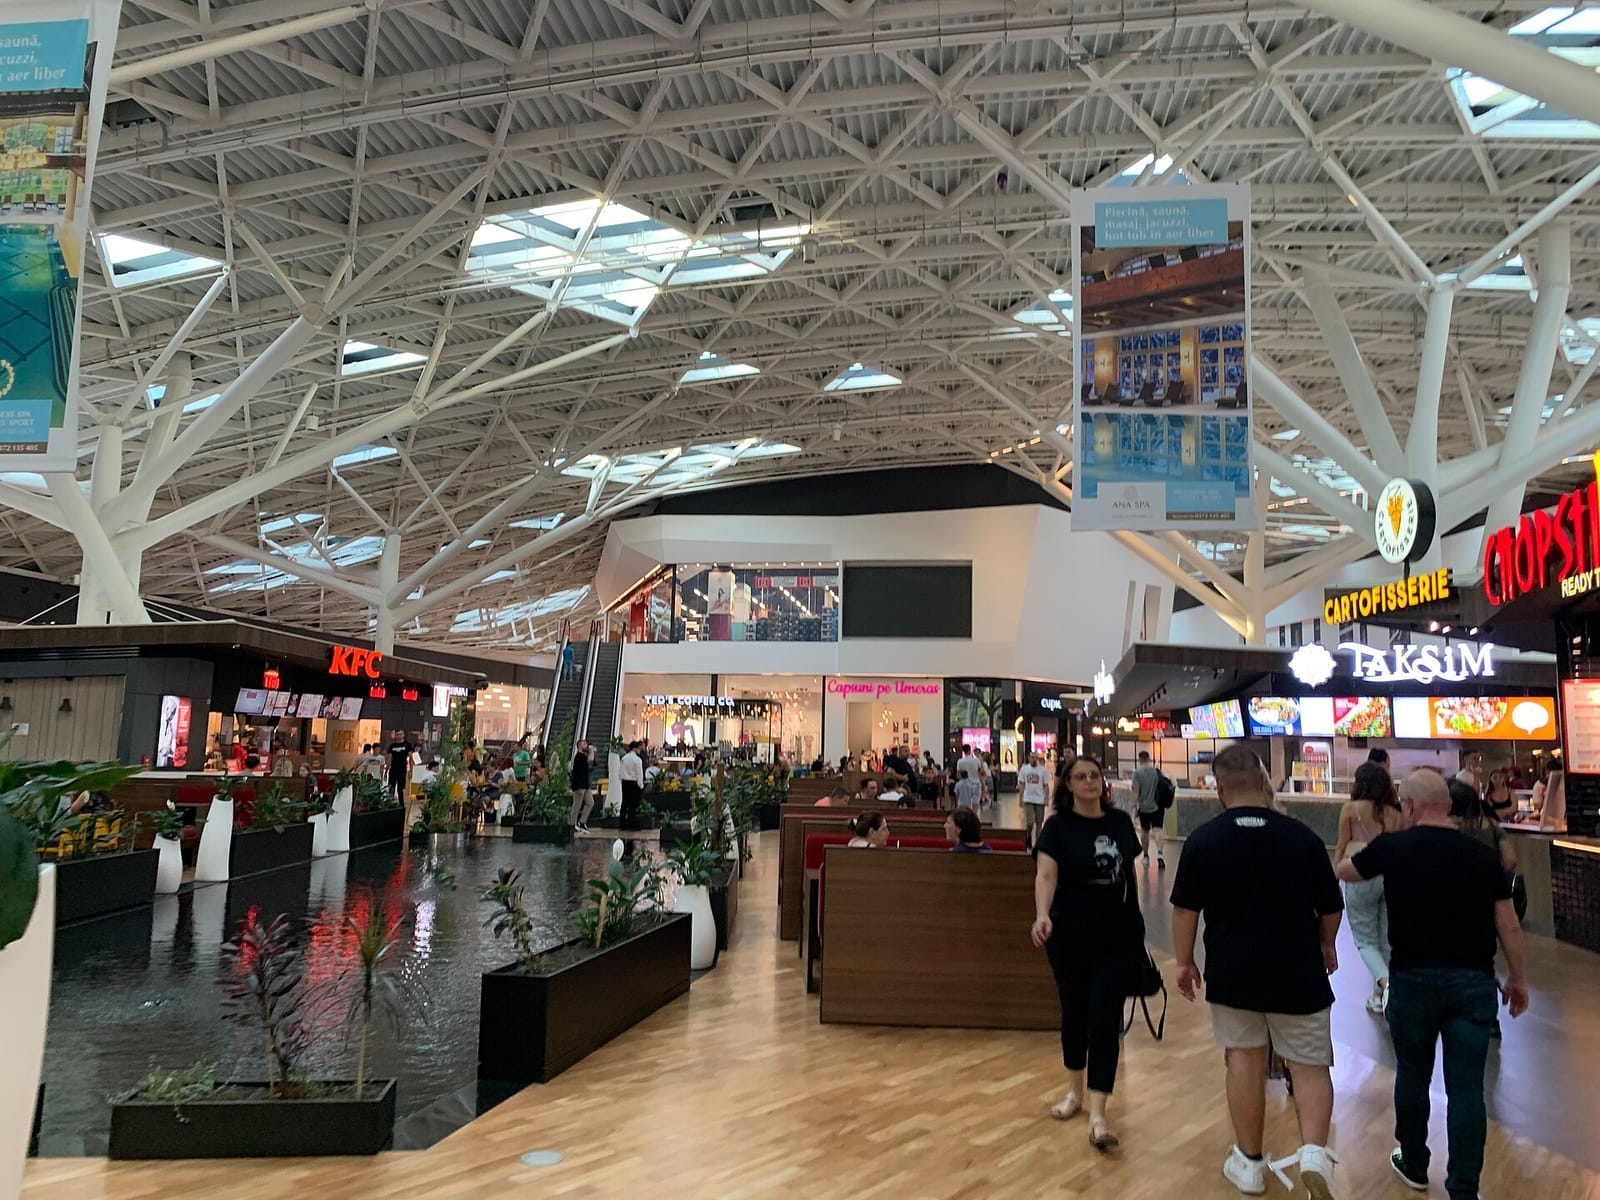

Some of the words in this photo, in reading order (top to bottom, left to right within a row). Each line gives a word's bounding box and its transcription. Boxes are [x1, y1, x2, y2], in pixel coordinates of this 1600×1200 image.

[7, 71, 30, 81] aer
[34, 66, 66, 80] liber
[1105, 230, 1123, 240] hot
[1187, 226, 1215, 238] liber
[1111, 501, 1132, 509] ANA
[1134, 501, 1151, 509] SPA
[1561, 570, 1593, 598] READY
[1324, 567, 1450, 625] CARTOFISSERIE
[329, 645, 384, 678] KFC
[876, 683, 892, 699] pe
[894, 680, 938, 694] Umeras
[677, 695, 716, 706] COFFEE
